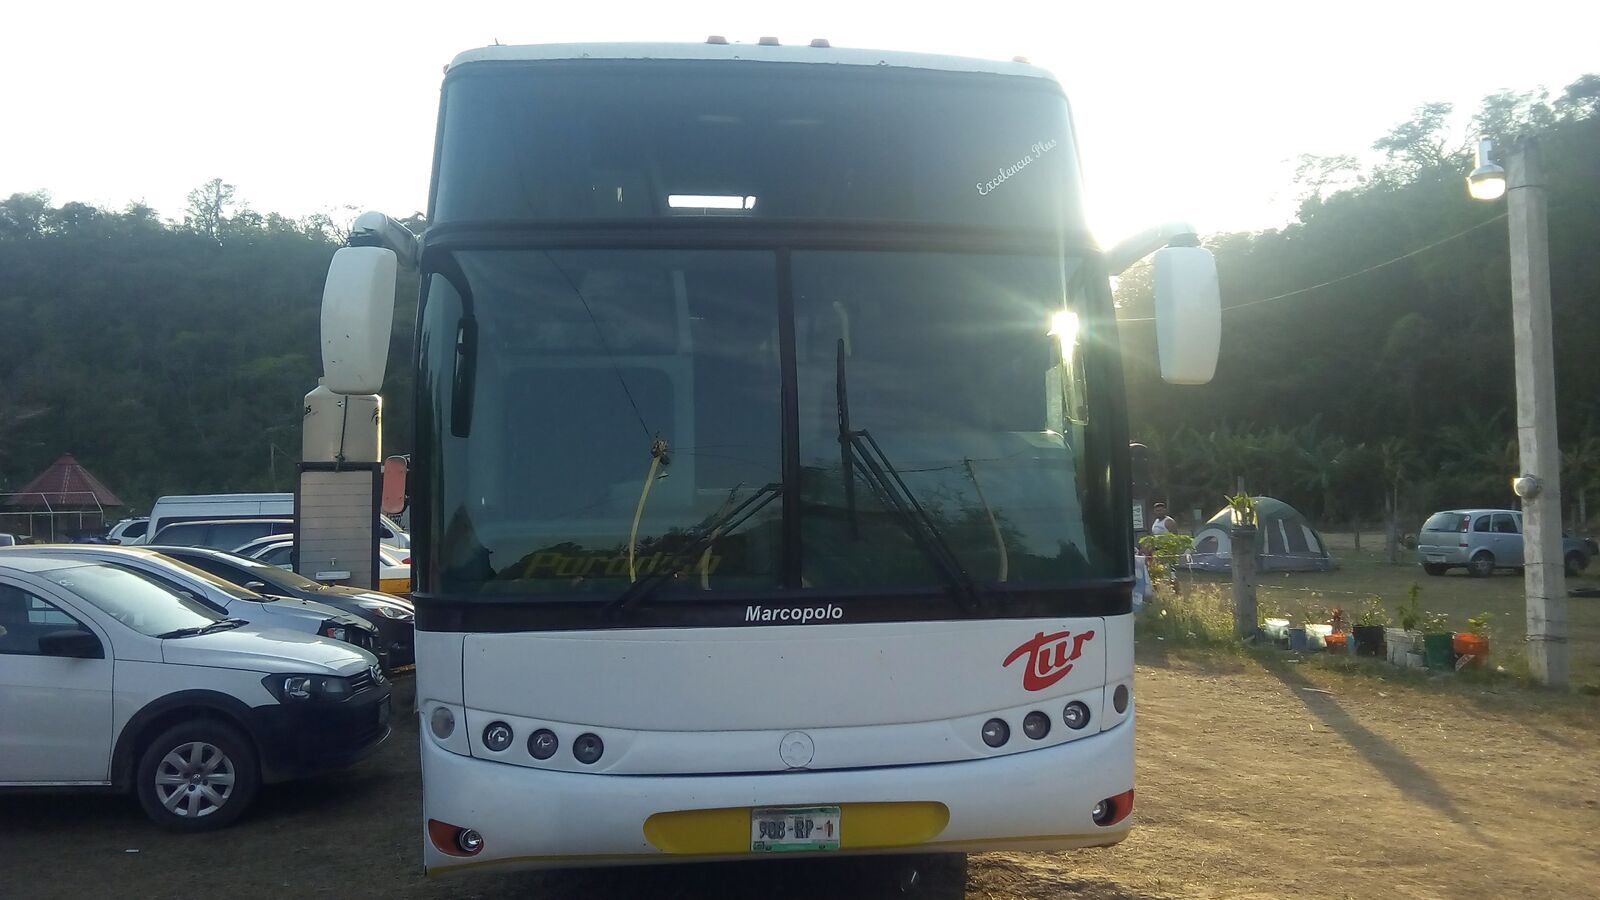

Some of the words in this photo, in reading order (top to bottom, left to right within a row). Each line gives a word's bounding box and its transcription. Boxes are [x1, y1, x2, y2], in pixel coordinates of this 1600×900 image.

[976, 155, 1033, 196] Excelencia
[1031, 139, 1057, 158] Plus
[745, 603, 843, 624] Marcopolo
